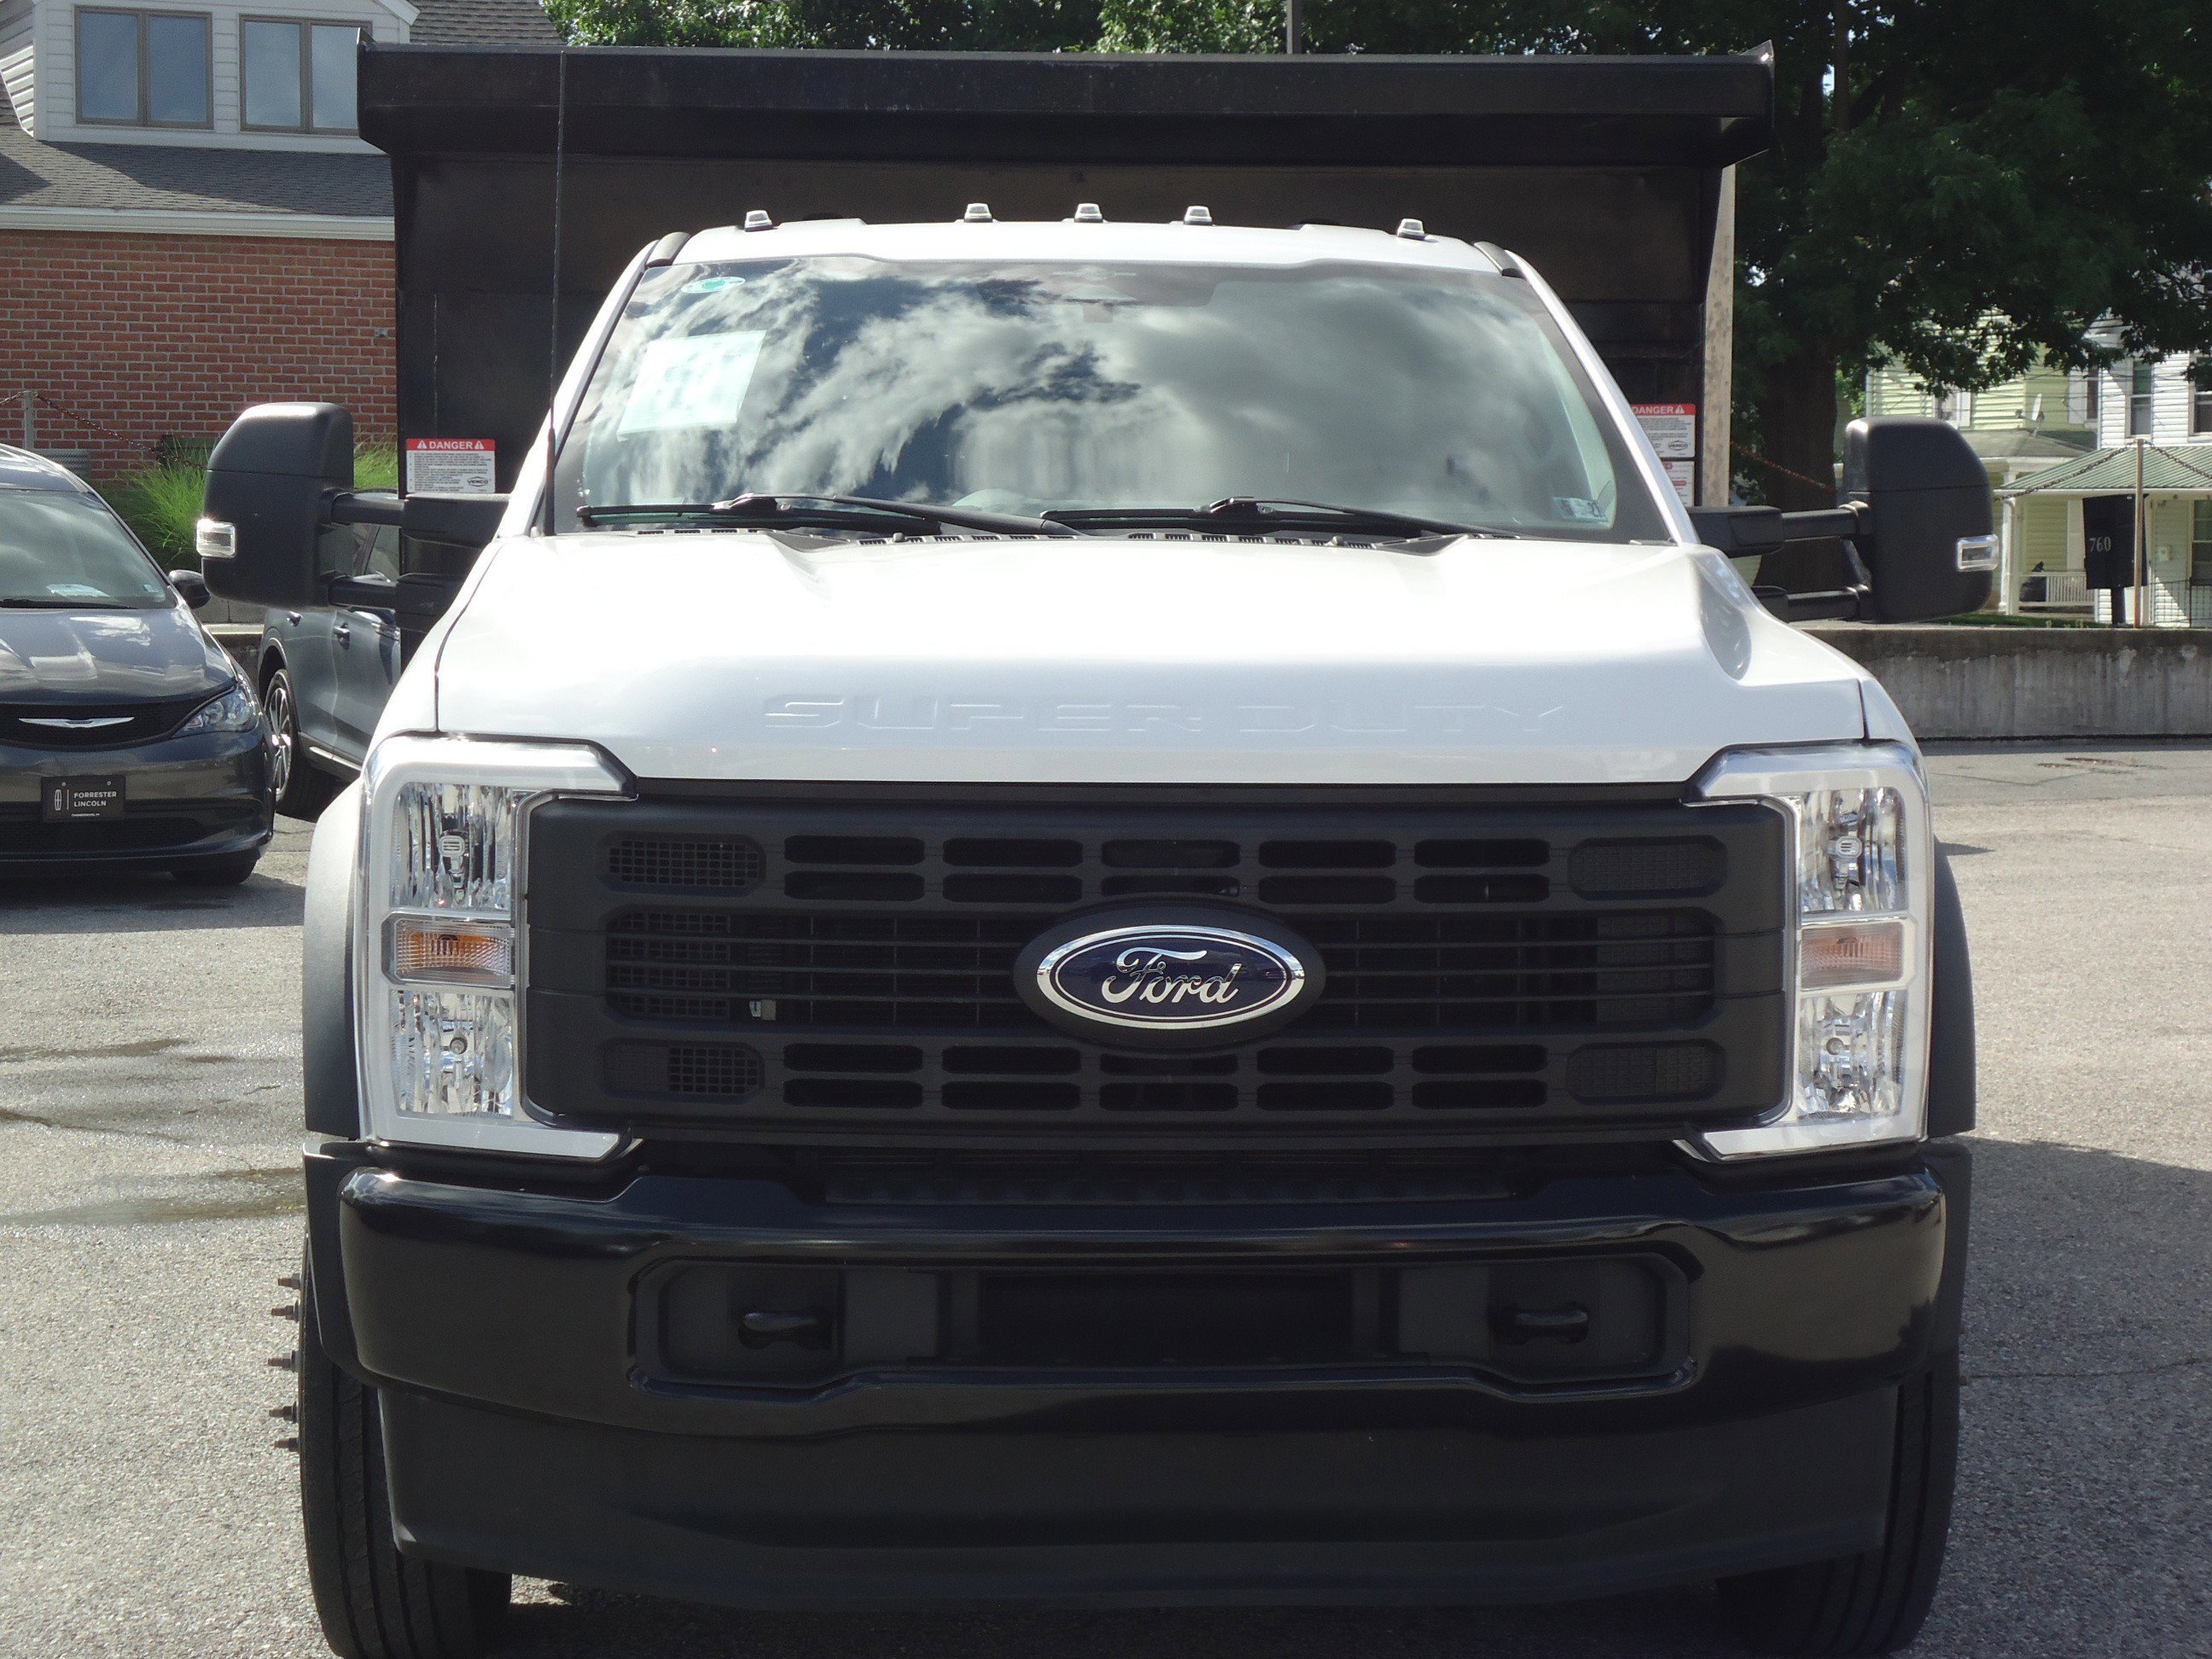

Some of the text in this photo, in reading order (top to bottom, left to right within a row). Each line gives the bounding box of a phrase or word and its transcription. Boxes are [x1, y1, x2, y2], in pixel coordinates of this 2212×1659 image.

[1632, 406, 1674, 415] DANGER
[429, 440, 473, 450] DANGER
[2089, 536, 2111, 552] 760
[763, 695, 1563, 733] SUPER DUTY
[1102, 946, 1243, 1004] Ford
